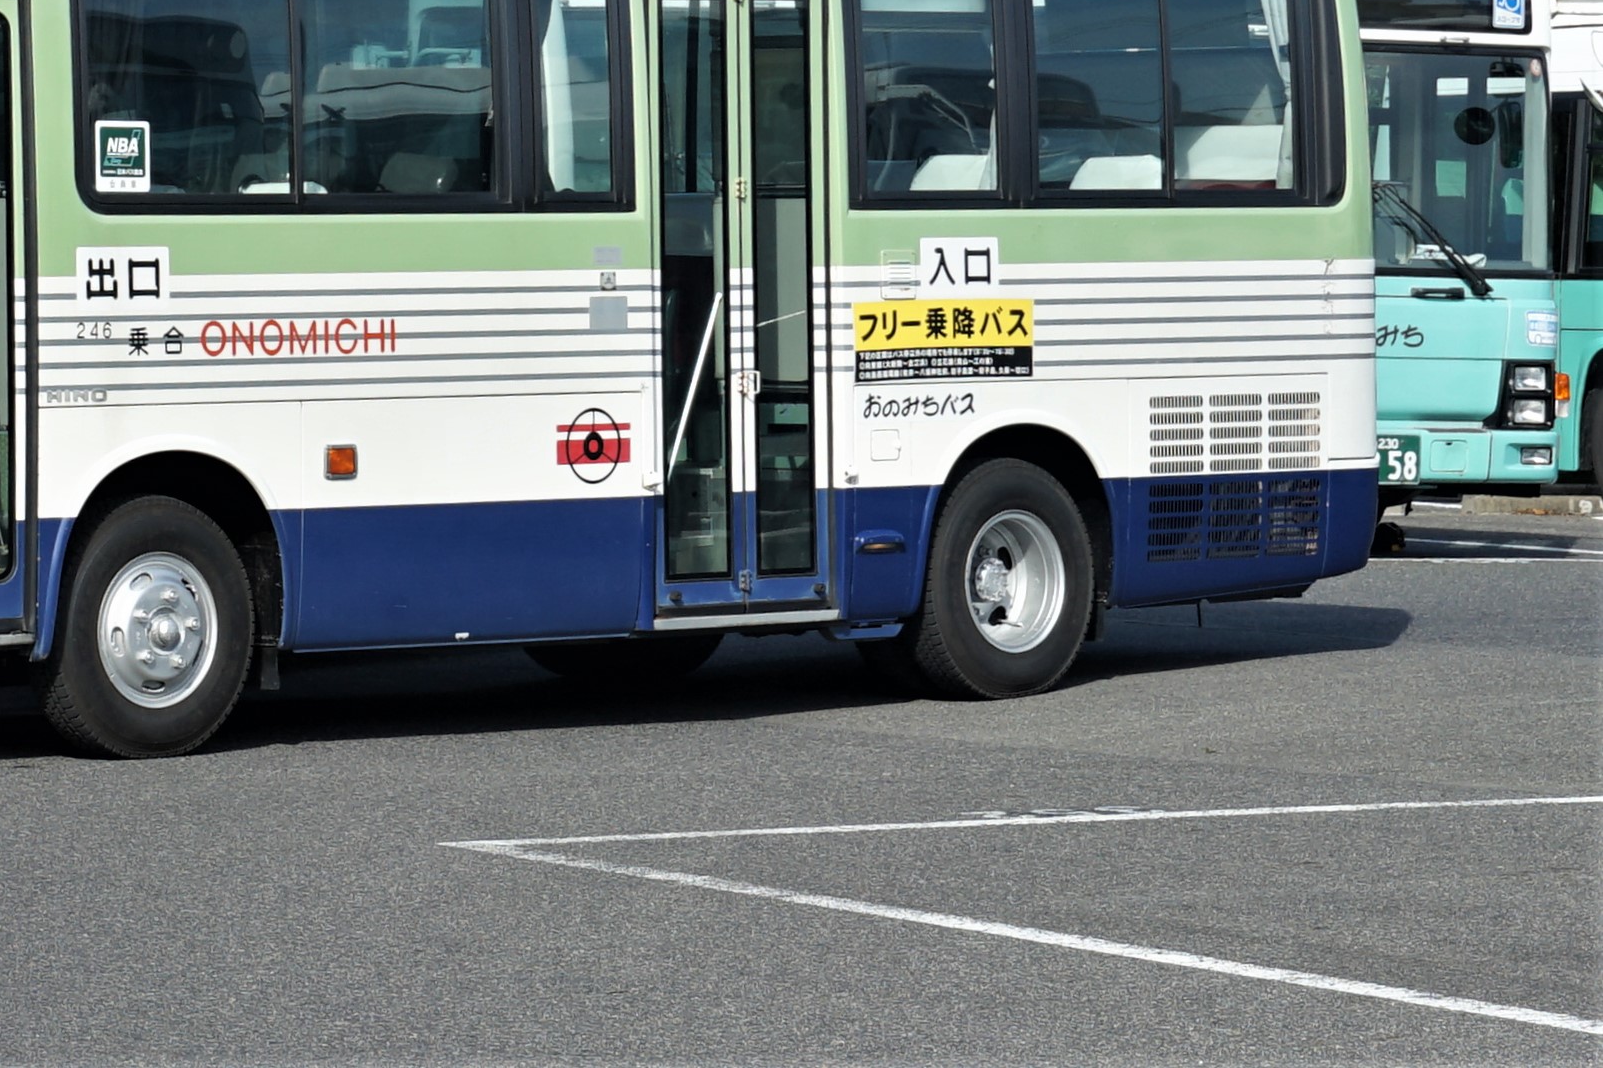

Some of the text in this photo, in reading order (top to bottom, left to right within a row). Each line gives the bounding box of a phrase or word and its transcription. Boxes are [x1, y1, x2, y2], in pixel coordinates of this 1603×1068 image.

[107, 137, 139, 153] NBA
[86, 258, 160, 300] 出口
[929, 247, 991, 285] 入口
[77, 322, 112, 339] 246
[201, 319, 396, 357] ONOMICHI
[859, 306, 1029, 342] フリー乗降バス
[1376, 324, 1424, 348] みち
[128, 326, 184, 356] 乗合
[47, 388, 107, 403] HINO
[863, 393, 975, 419] おのみちバス
[1378, 438, 1399, 449] 230
[1377, 450, 1417, 481] 58
